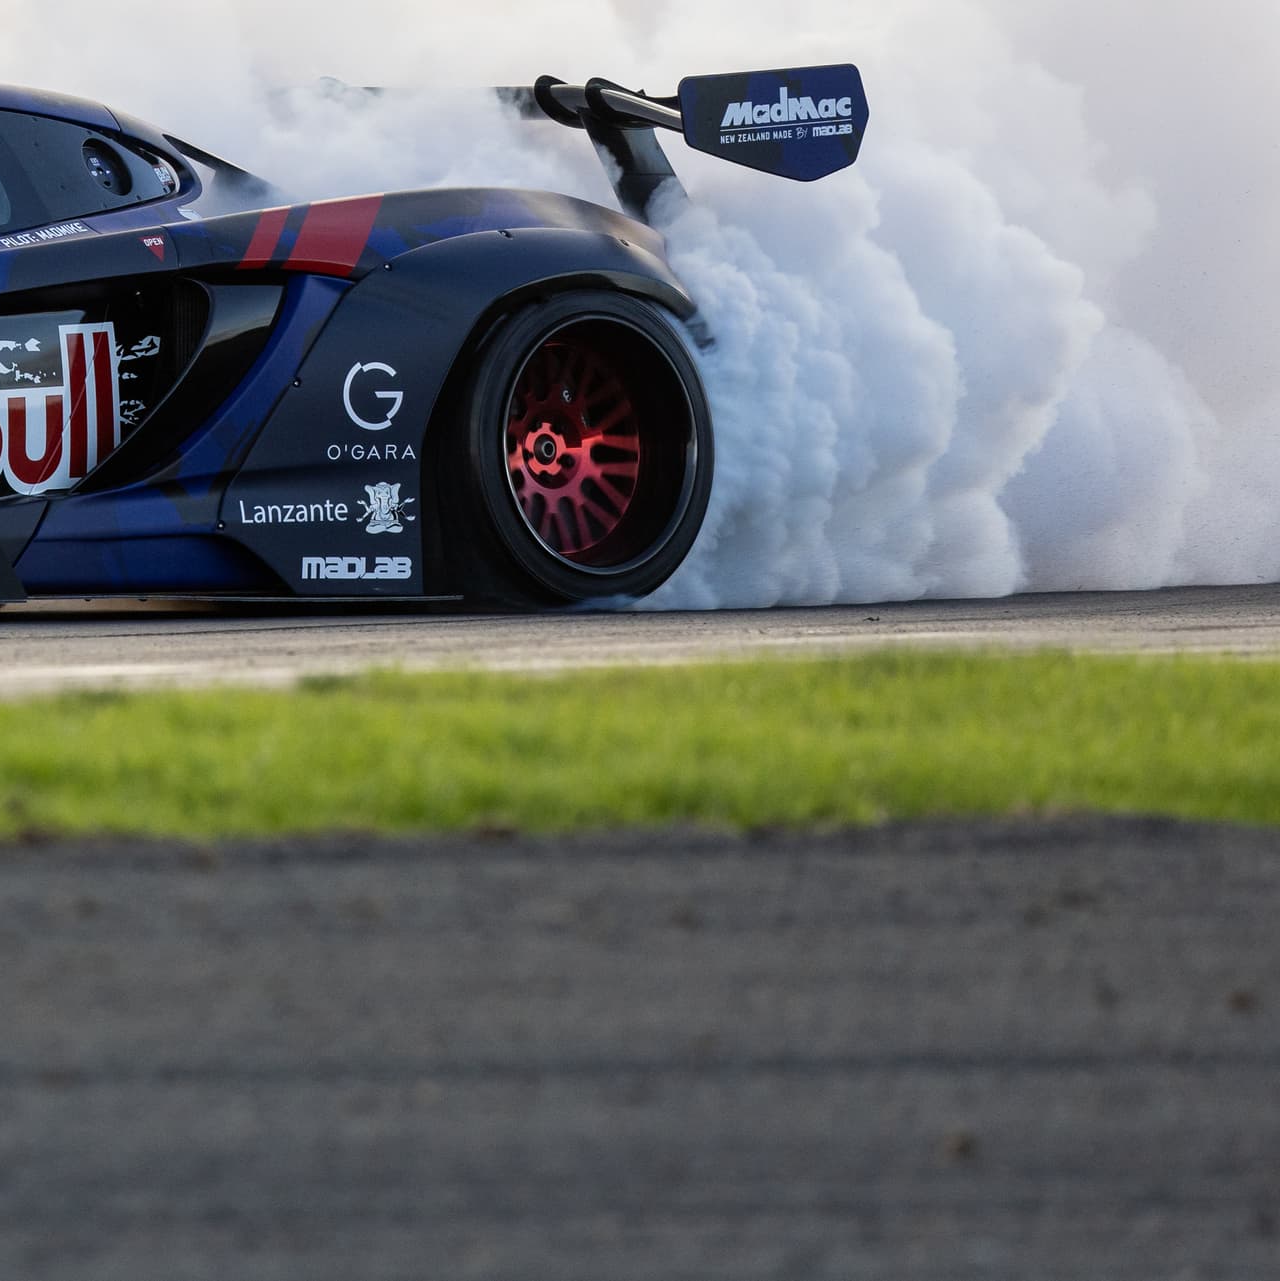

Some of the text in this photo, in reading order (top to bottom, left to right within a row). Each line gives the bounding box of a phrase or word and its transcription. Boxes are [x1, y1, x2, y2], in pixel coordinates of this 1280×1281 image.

[720, 86, 852, 127] MadMac
[720, 135, 735, 144] NEW
[738, 131, 770, 143] ZEALAND
[773, 129, 792, 139] MADE
[0, 222, 88, 248] PILOT: MADMIKE
[143, 237, 164, 247] OPEN
[327, 443, 416, 460] O'GARA
[239, 499, 349, 524] Lanzante
